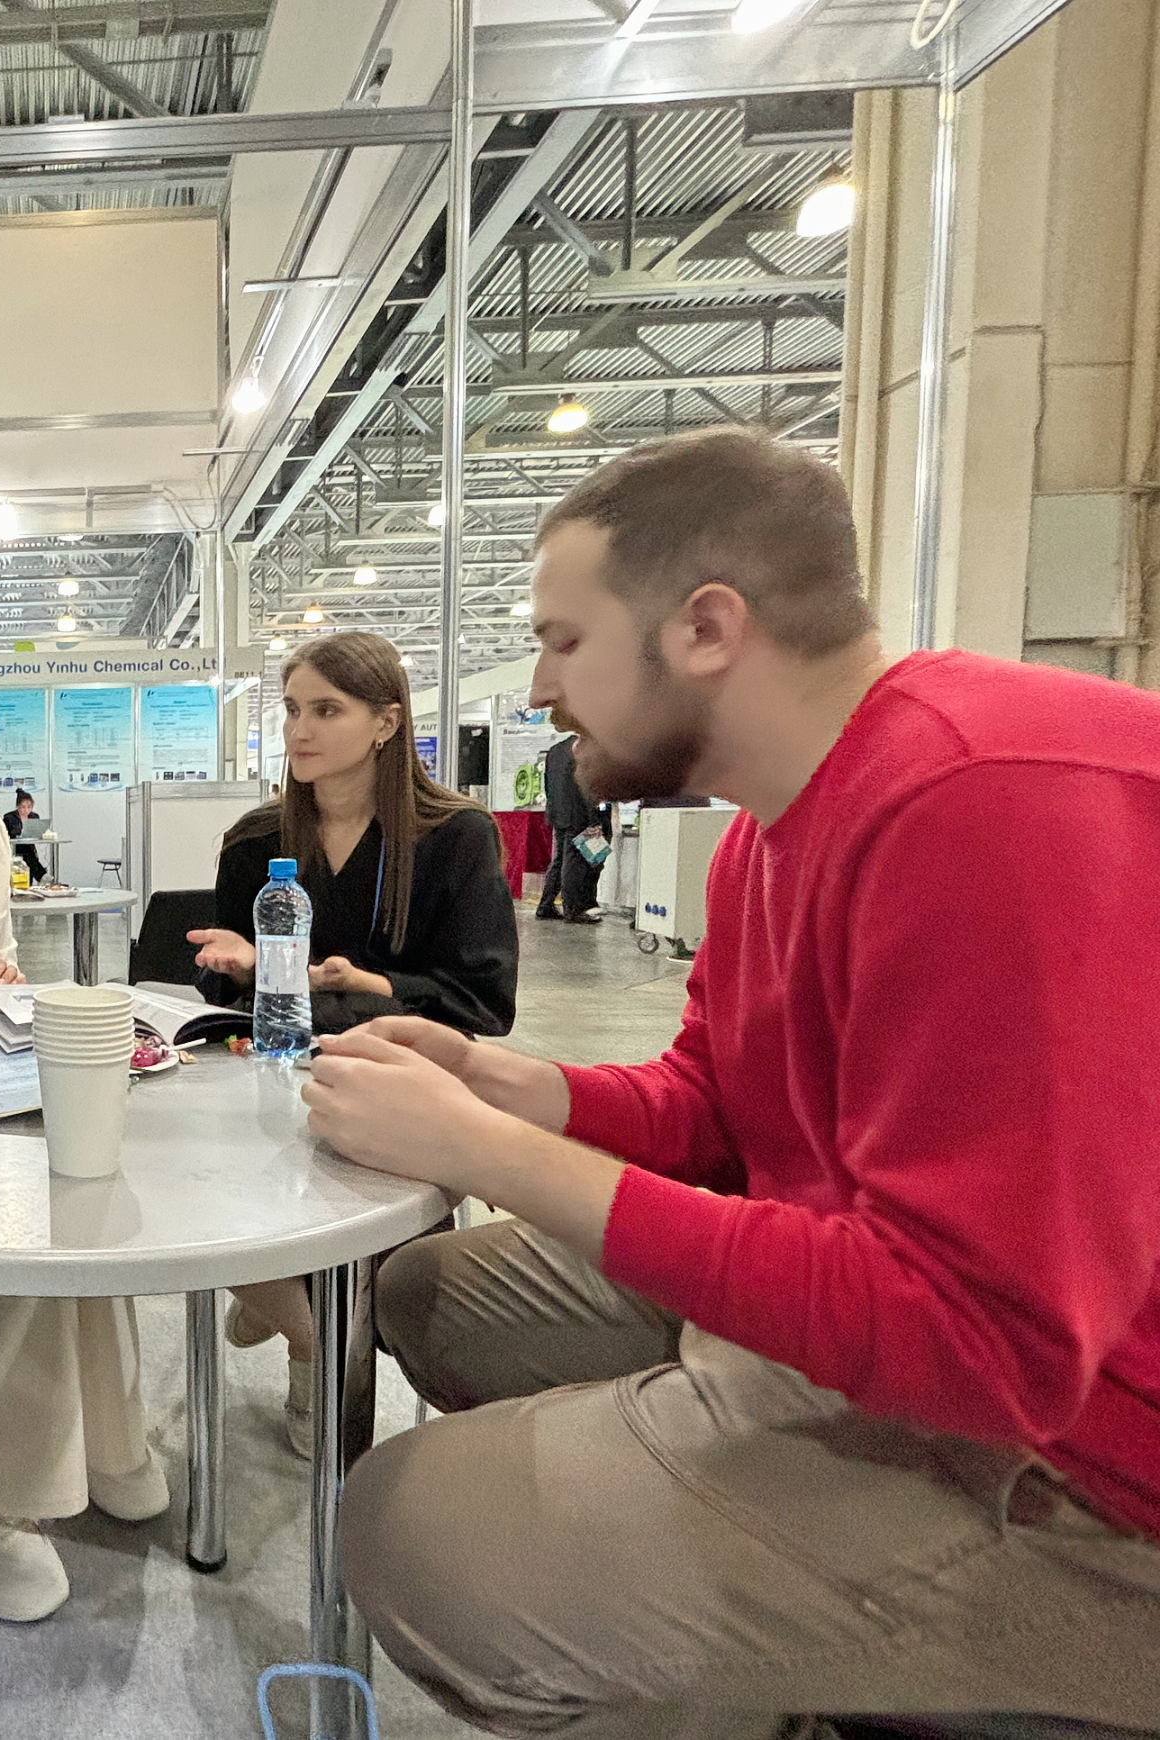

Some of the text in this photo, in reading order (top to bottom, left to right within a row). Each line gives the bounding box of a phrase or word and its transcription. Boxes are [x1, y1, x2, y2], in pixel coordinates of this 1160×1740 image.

[46, 661, 88, 673] Yinhu
[93, 659, 164, 673] Chemical
[169, 657, 227, 673] Co.,Lt
